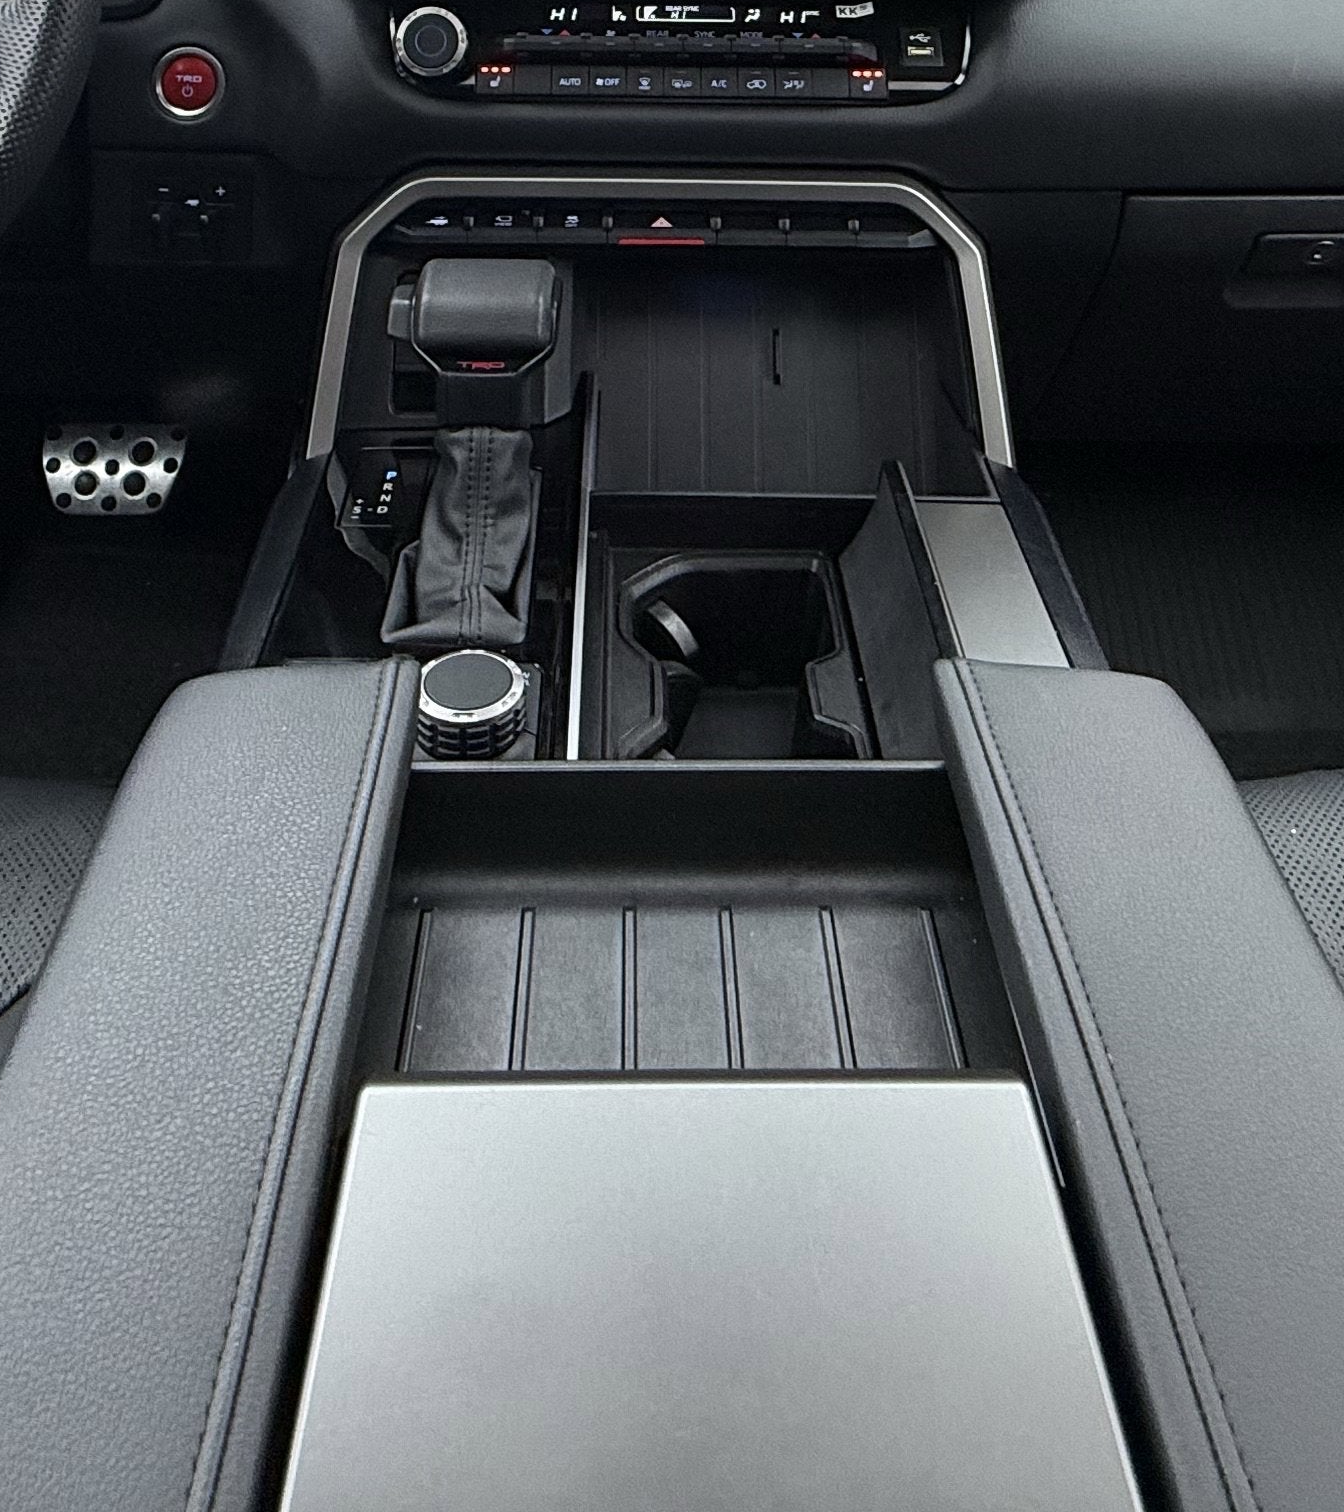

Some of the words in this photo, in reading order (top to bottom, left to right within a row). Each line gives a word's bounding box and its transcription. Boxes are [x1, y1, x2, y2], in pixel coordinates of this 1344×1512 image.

[550, 8, 579, 21] HI
[839, 7, 857, 16] KK
[175, 74, 203, 83] TRD
[559, 77, 582, 87] AUTO
[604, 77, 621, 87] OFF
[711, 80, 728, 89] A/C
[457, 360, 506, 370] TRD
[386, 471, 398, 480] P
[382, 482, 394, 491] R
[379, 493, 392, 502] N
[352, 505, 362, 514] S
[376, 505, 389, 514] D
